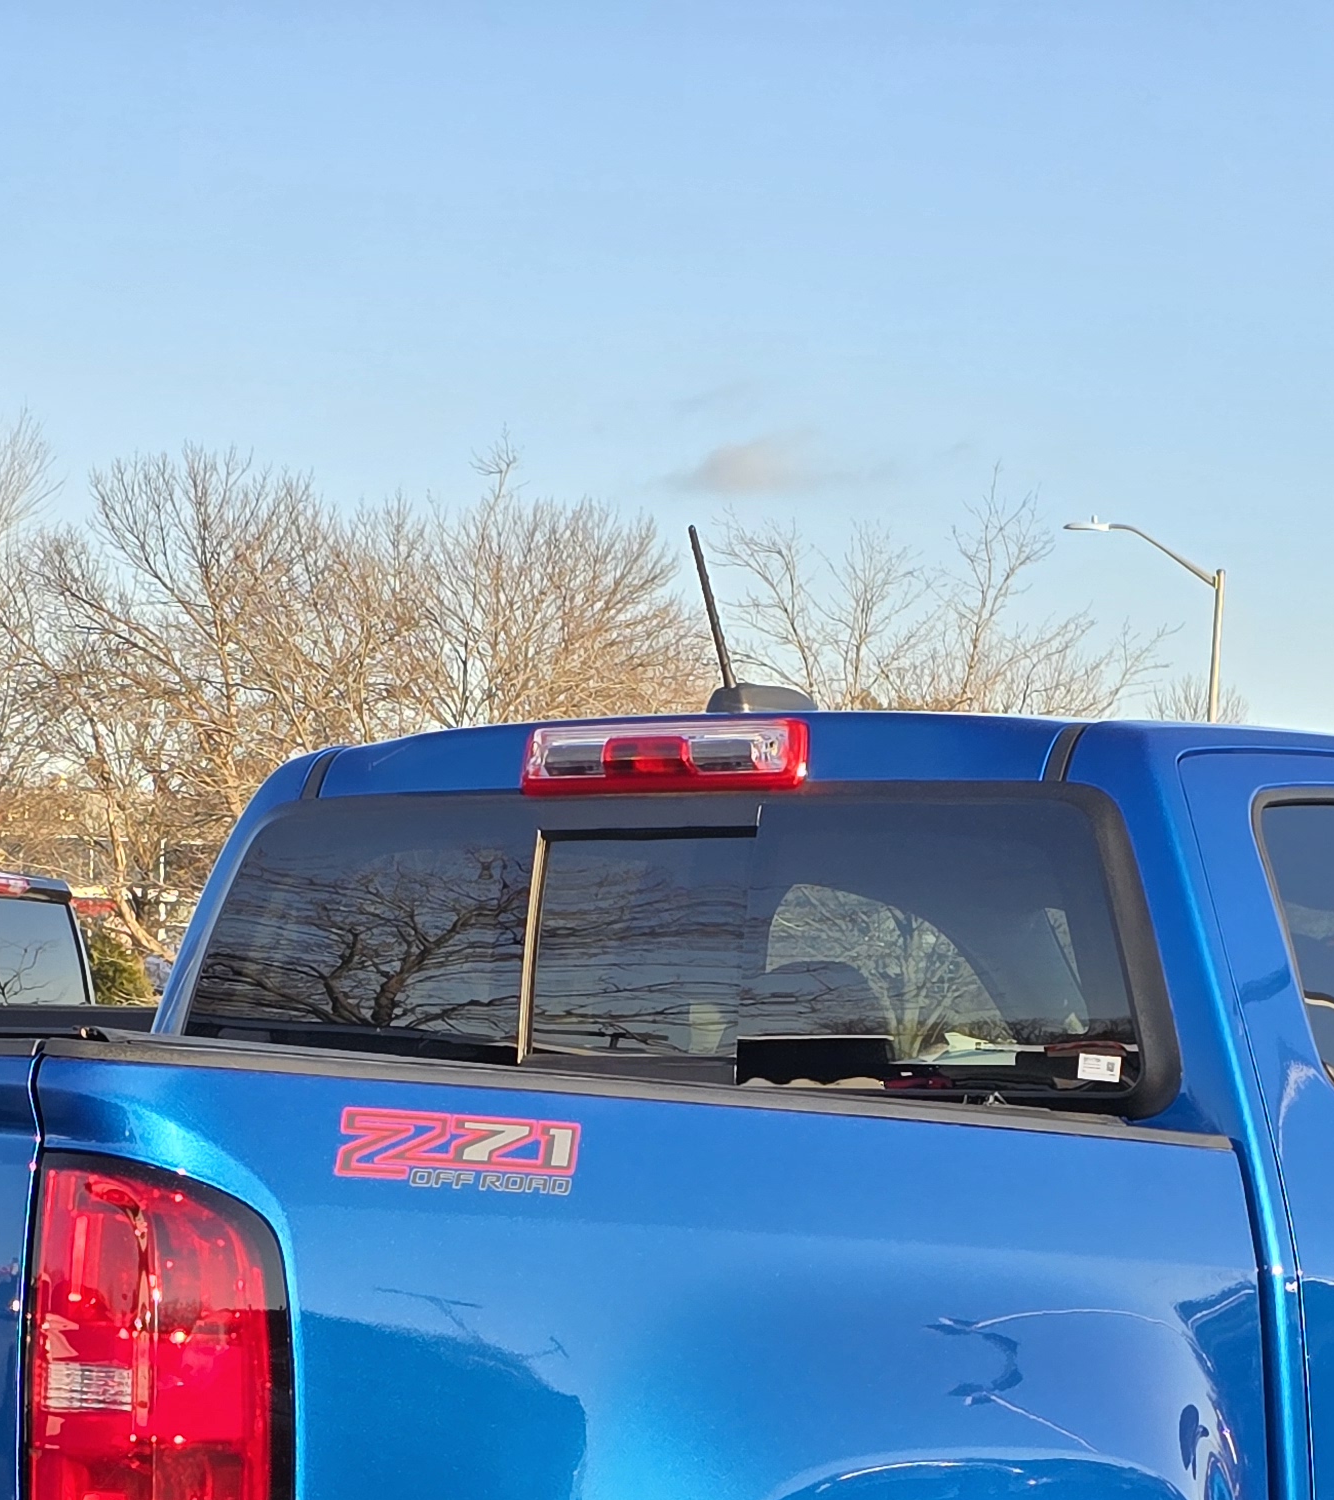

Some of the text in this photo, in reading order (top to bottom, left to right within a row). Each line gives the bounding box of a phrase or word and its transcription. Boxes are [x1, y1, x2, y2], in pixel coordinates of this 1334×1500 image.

[334, 1107, 581, 1179] Z71
[410, 1169, 573, 1196] OFF ROAD
